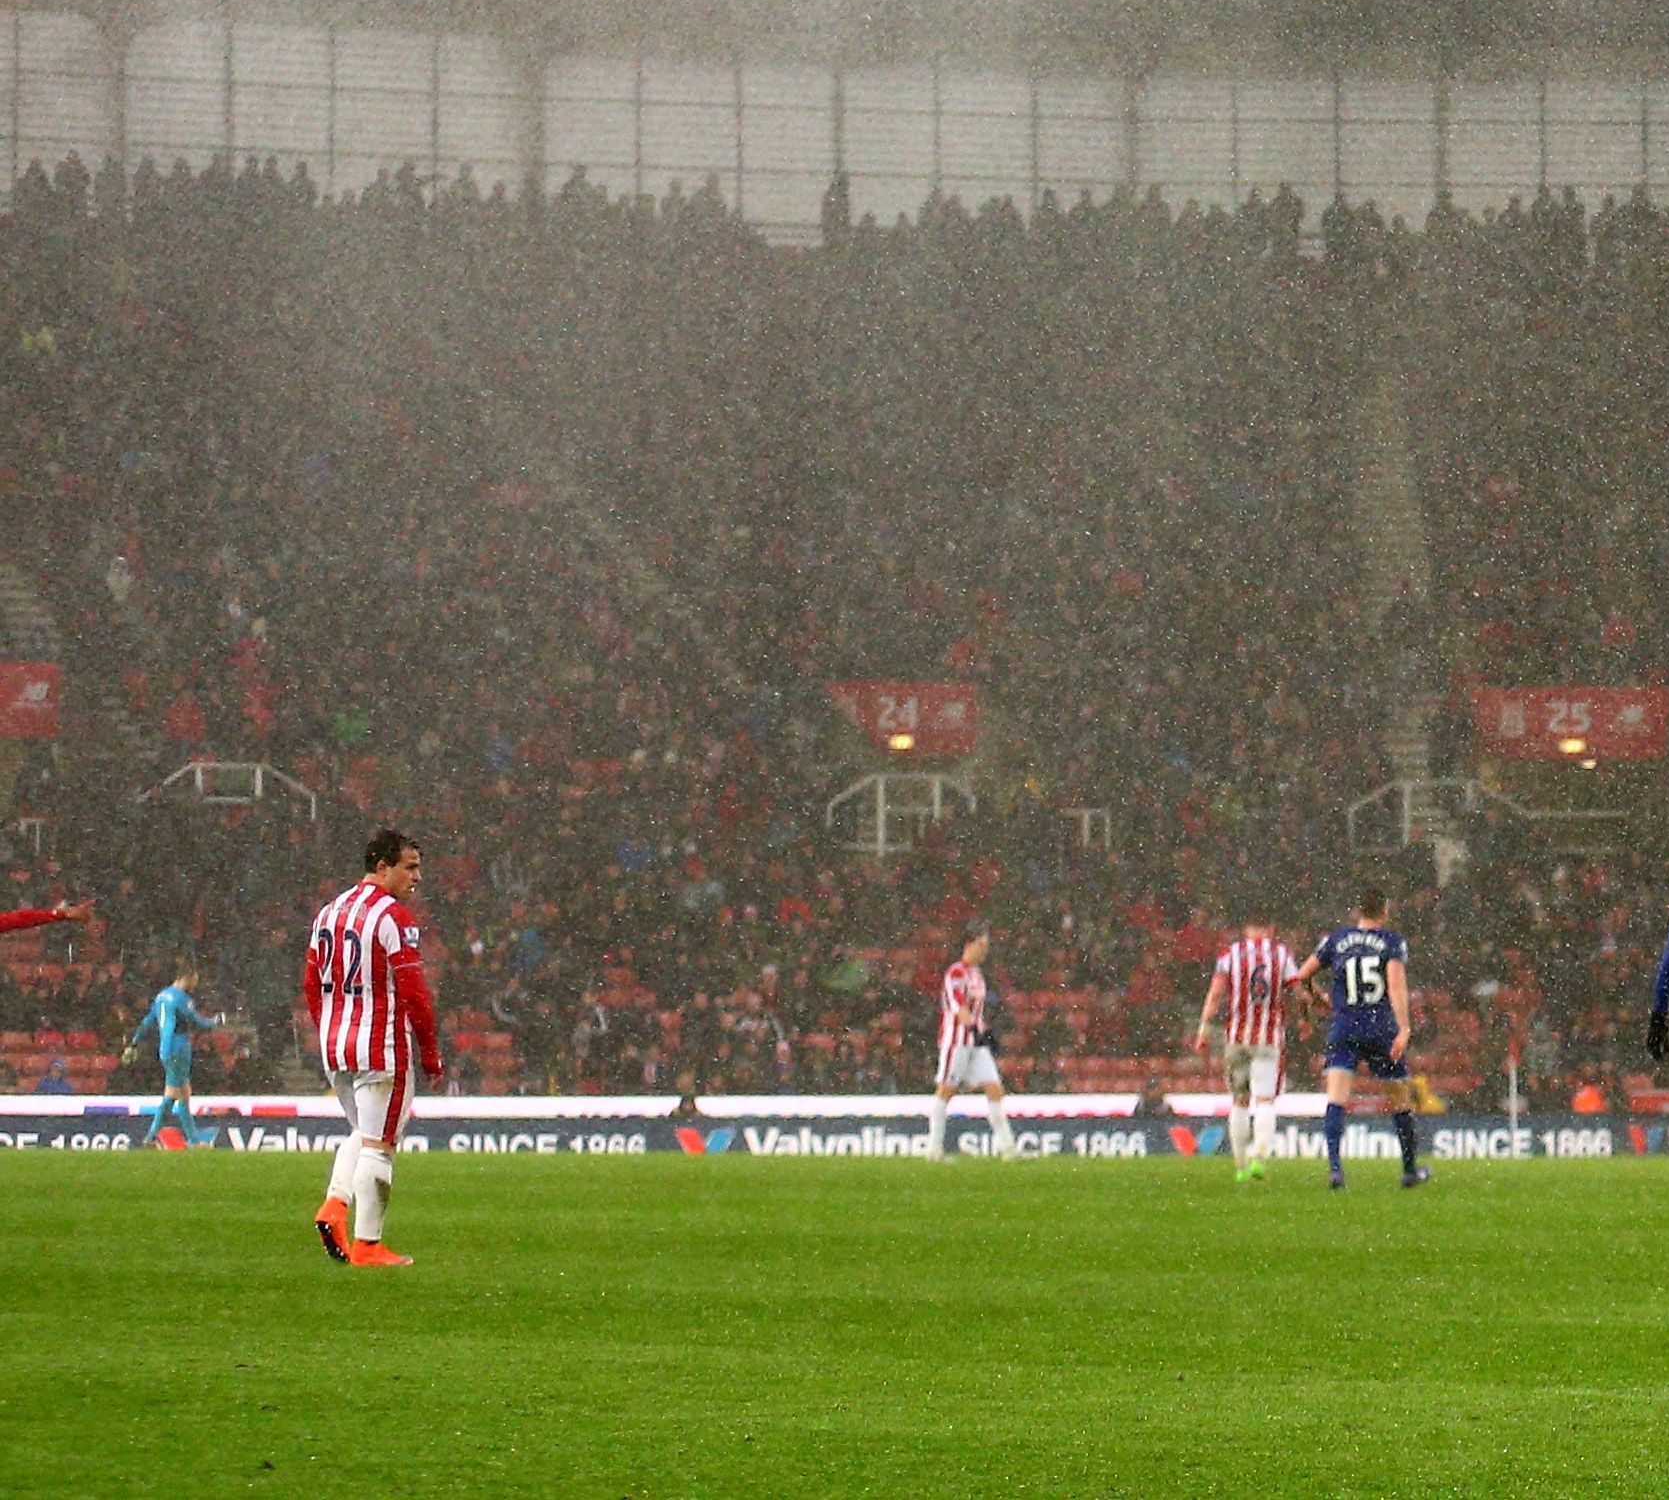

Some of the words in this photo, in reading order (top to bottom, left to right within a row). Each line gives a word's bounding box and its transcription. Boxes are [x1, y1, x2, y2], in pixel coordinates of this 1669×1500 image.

[878, 695, 919, 730] 24
[1547, 699, 1592, 735] 25
[316, 927, 364, 996] 22
[1250, 964, 1269, 1002] 6
[1345, 955, 1386, 1006] 15
[1432, 1129, 1532, 1159] SINCE
